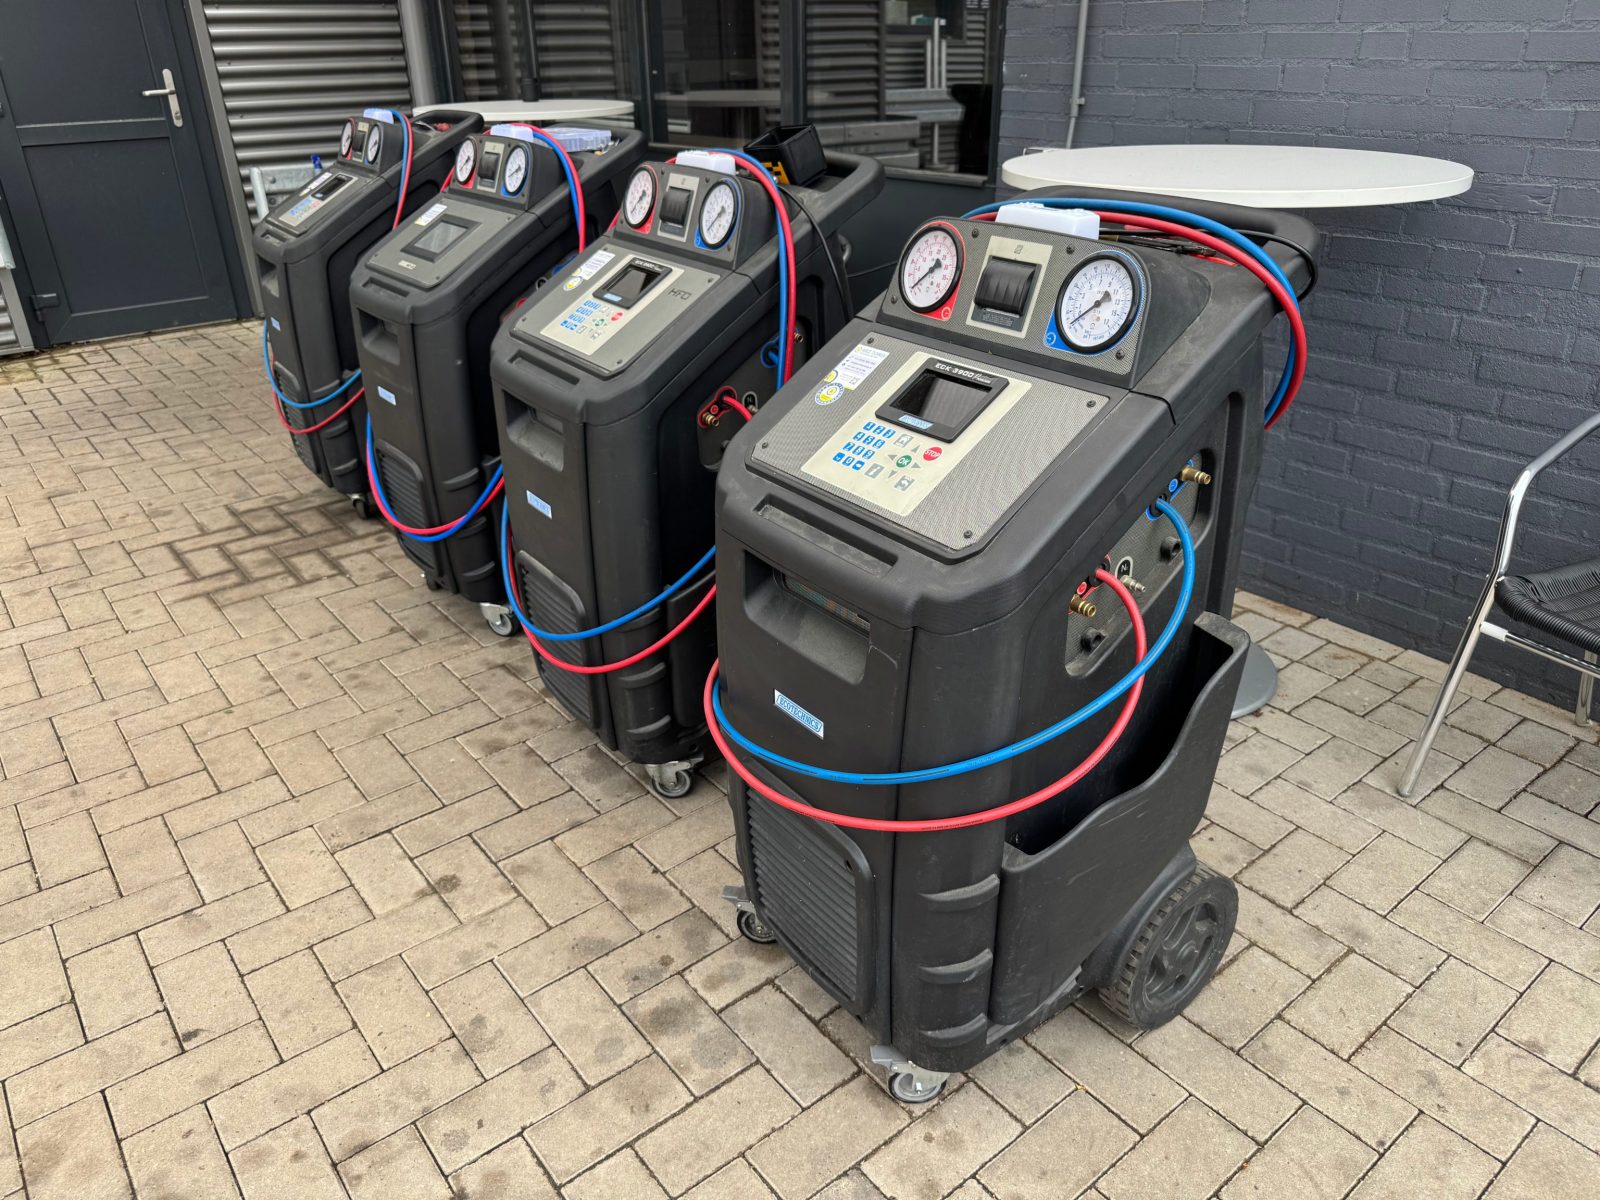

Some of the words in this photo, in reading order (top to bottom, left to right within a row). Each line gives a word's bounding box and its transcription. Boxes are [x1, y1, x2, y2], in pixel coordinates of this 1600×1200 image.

[668, 288, 692, 301] HFO
[952, 368, 975, 378] 3900
[924, 449, 941, 458] STOP
[898, 457, 909, 466] OK
[779, 696, 820, 731] ECOTECHNICS
